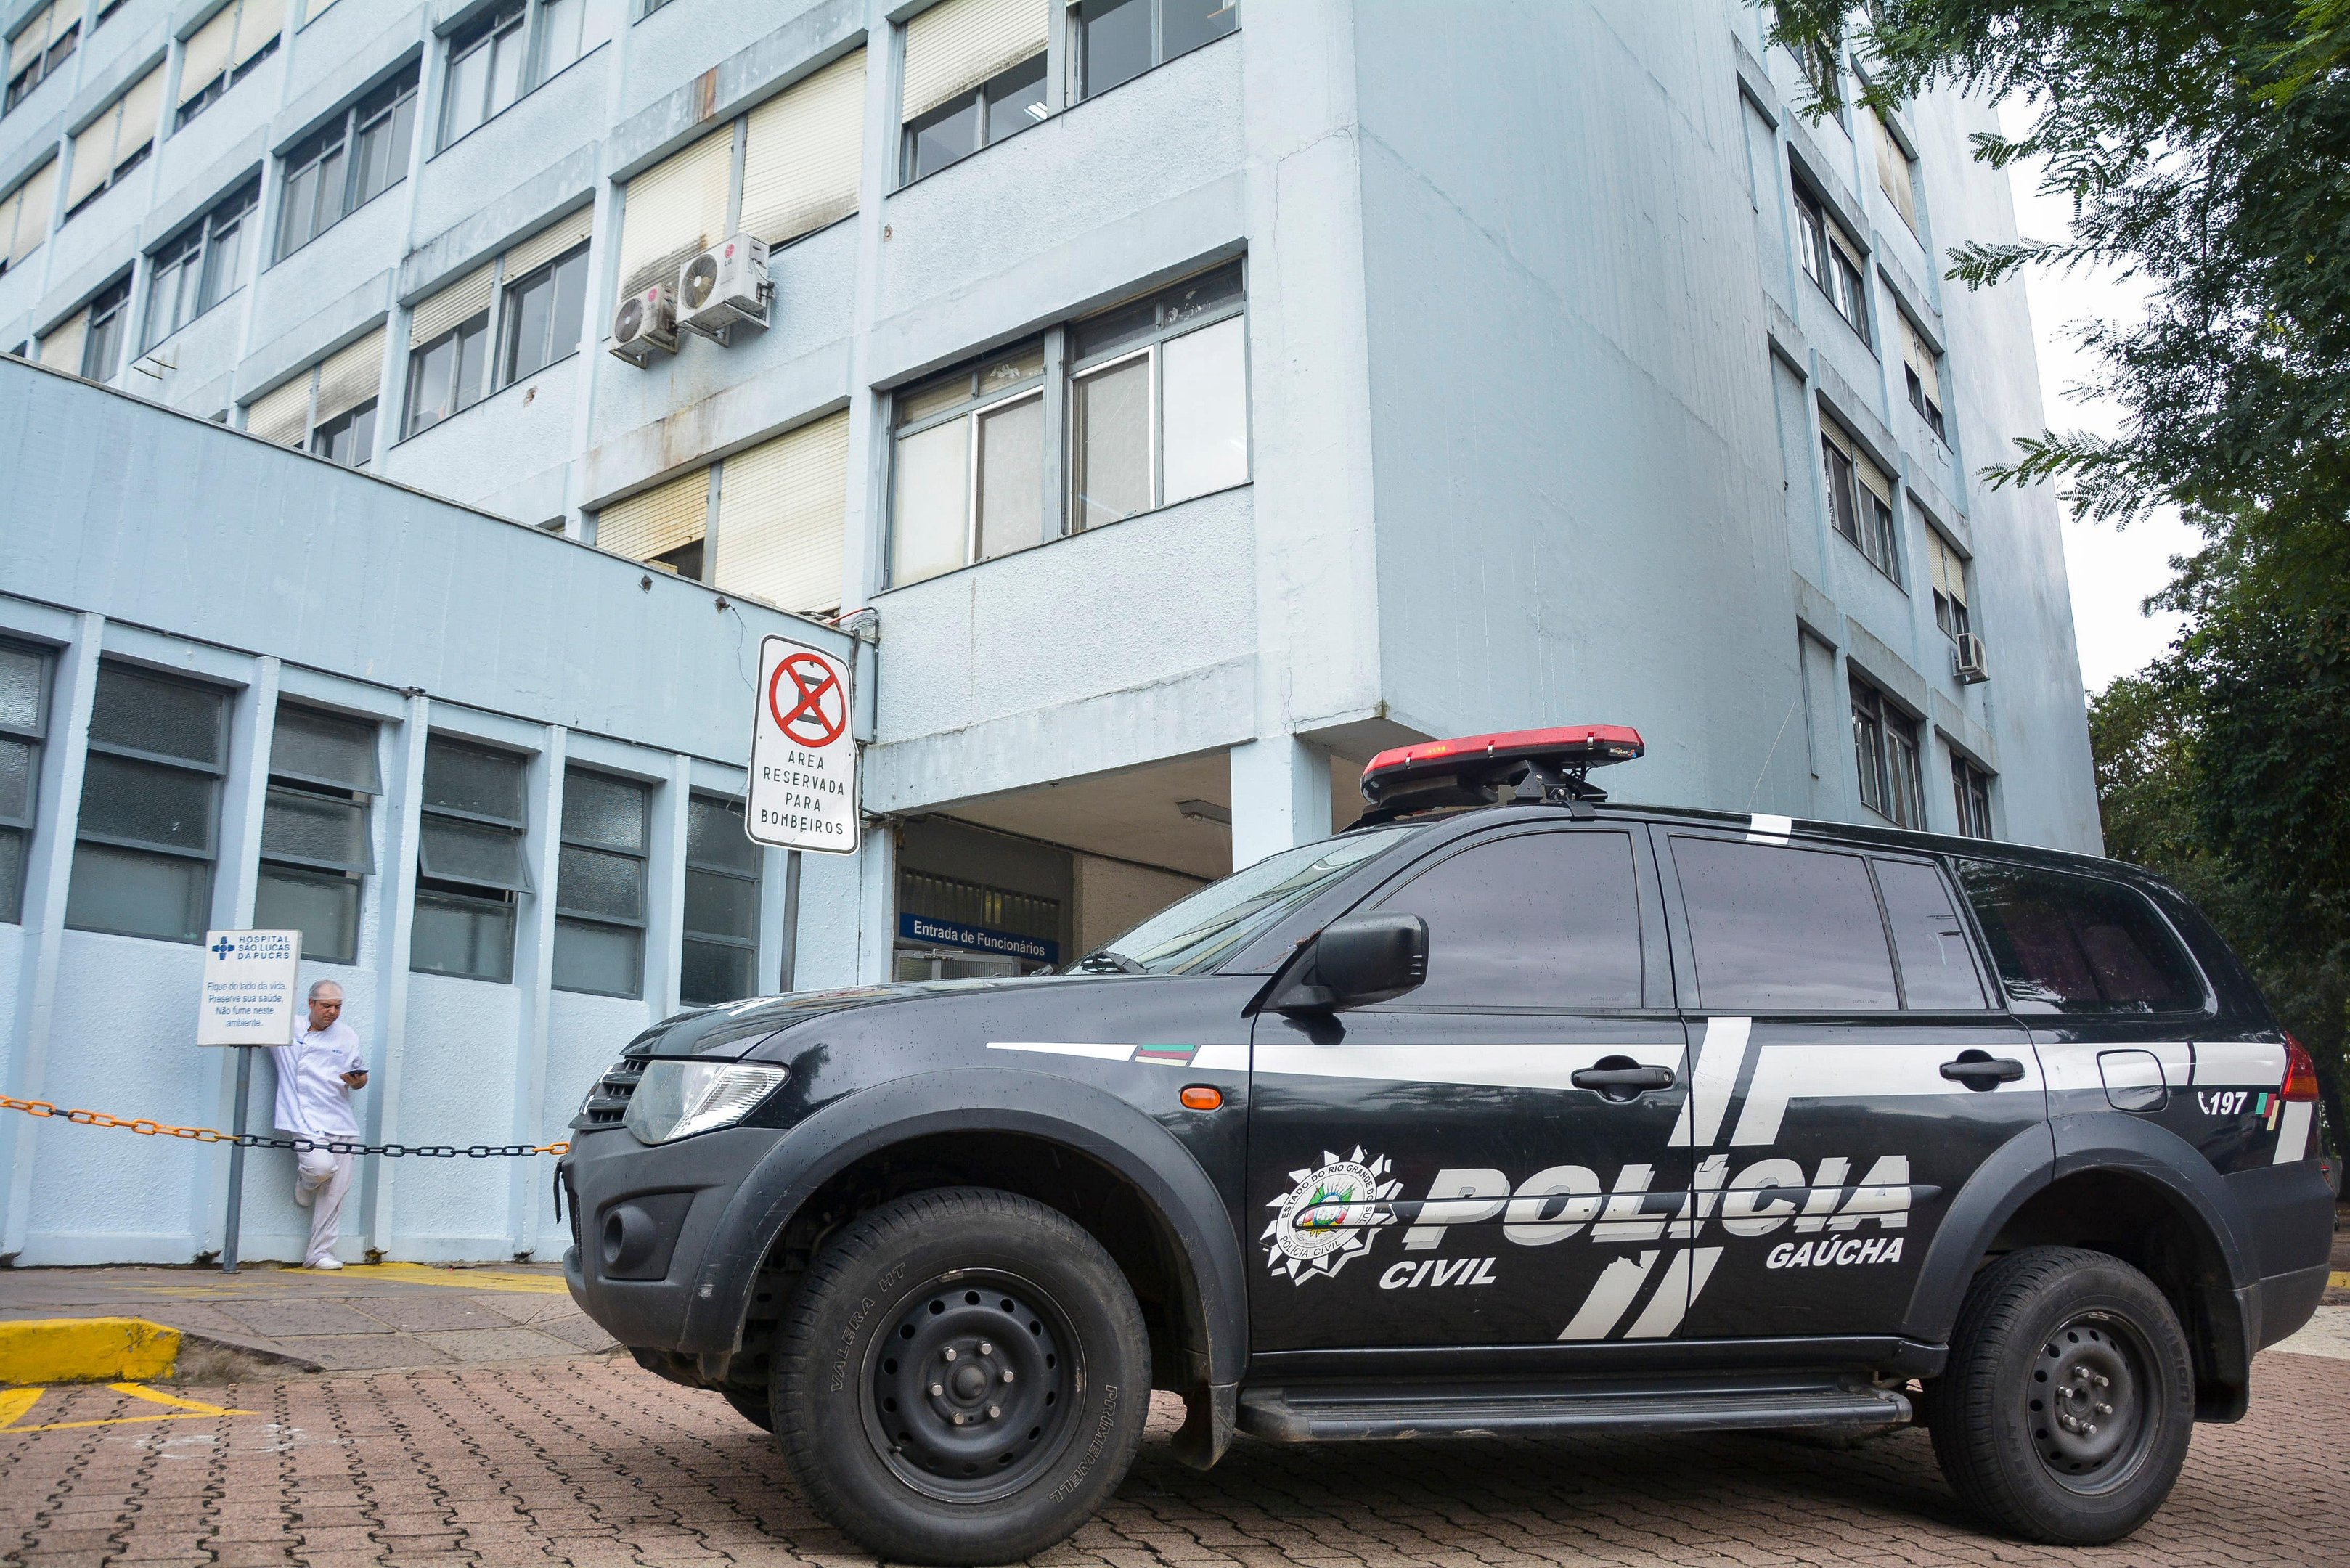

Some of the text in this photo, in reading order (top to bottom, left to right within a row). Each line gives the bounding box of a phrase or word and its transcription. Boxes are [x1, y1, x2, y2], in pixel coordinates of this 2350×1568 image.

[788, 750, 824, 770] AREA
[763, 766, 844, 796] RESERVADA
[786, 792, 821, 812] PARA
[761, 809, 843, 835] BOMBEIROS
[238, 942, 257, 952] SÃO
[914, 920, 1045, 956] Entrada de Funcionários
[207, 982, 227, 992] Fique
[270, 981, 287, 990] vida.
[216, 1006, 231, 1015] Não
[232, 1006, 250, 1015] fume
[2210, 1091, 2248, 1115] 197
[1281, 1164, 1374, 1225] ESTADO DO RIO GRANDE DO SUL
[1401, 1154, 1912, 1251] POLÍCIA
[1280, 1235, 1309, 1257] POLÍCIA
[1313, 1241, 1342, 1256] CIVIL
[1766, 1233, 1904, 1269] GAÚCHA
[1379, 1258, 1497, 1289] CIVIL
[831, 1262, 906, 1392] VALERA HT
